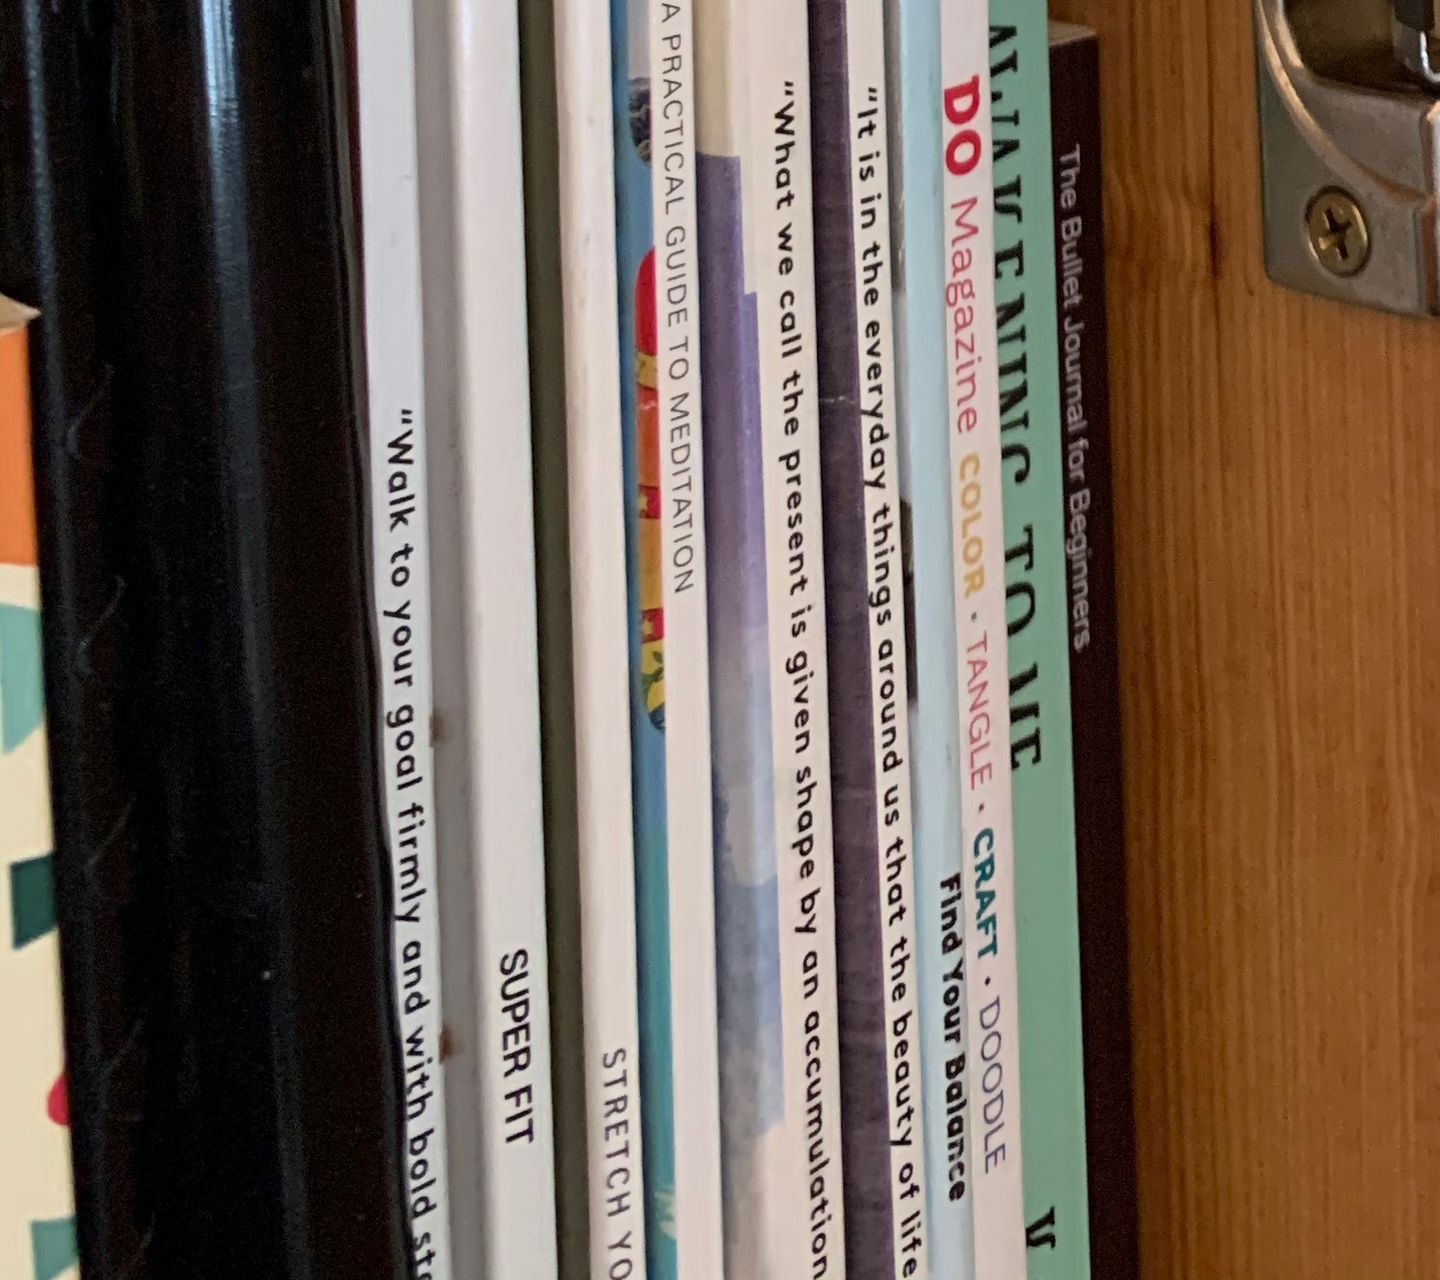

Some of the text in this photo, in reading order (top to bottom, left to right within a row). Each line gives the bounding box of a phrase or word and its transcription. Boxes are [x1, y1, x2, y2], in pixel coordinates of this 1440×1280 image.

[661, 2, 682, 23] A
[662, 33, 686, 215] PRACTICAL
[858, 150, 880, 182] is
[778, 221, 794, 277] we
[860, 193, 882, 230] in
[665, 225, 689, 327] GUIDE
[862, 240, 883, 307] the
[668, 336, 690, 380] TO
[780, 290, 802, 359] call
[783, 369, 804, 436] the
[860, 319, 890, 490] everyday
[1059, 142, 1091, 653] The Bullet Journal for Beginners
[670, 392, 694, 594] MEDITATION
[778, 449, 809, 596] present
[389, 543, 415, 588] to
[868, 502, 896, 627] things
[383, 599, 413, 688] your
[790, 604, 812, 638] is
[944, 74, 1007, 1174] DO Magazine COLOR TANGLE CRAFT DOODLE
[386, 703, 423, 791] goal
[786, 650, 815, 754] given
[877, 638, 903, 773] around
[791, 765, 818, 880] shape
[883, 784, 900, 828] us
[394, 802, 428, 924] firmly
[886, 836, 907, 928] that
[794, 886, 821, 934] by
[403, 941, 431, 1015] and
[802, 950, 819, 1000] an
[889, 936, 911, 1003] the
[405, 1026, 434, 1121] with
[499, 948, 535, 1144] SUPER FIT
[889, 1009, 915, 1147] beauty
[940, 872, 966, 1203] Find Your Balance
[409, 1128, 438, 1221] bold
[602, 1047, 631, 1218] STRETCH
[804, 1009, 833, 1280] accumulation
[898, 1162, 921, 1200] of
[900, 1209, 923, 1279] life
